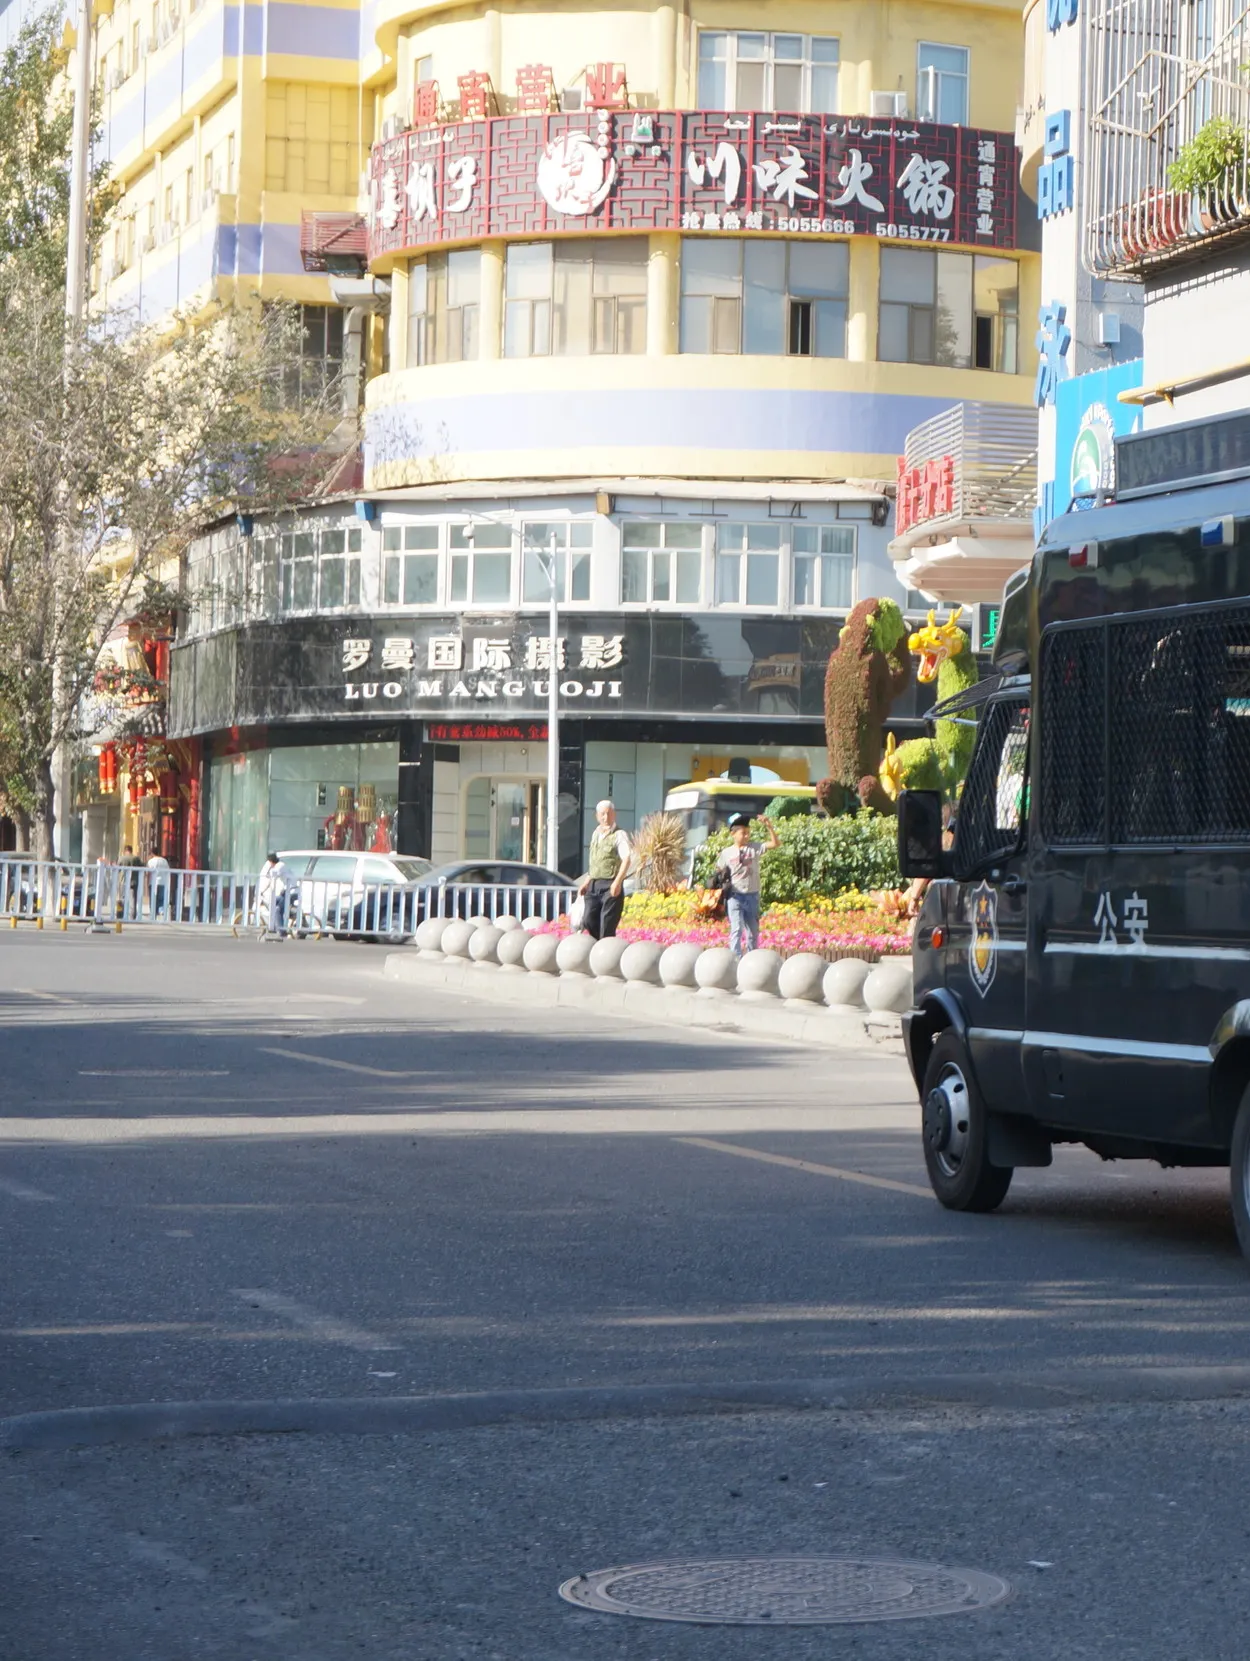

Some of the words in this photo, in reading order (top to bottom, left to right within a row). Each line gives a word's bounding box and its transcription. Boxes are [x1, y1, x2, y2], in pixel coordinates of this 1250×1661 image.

[687, 142, 956, 220] 川味火锅
[975, 140, 997, 236] 通宵营业
[876, 222, 951, 242] 5055777
[342, 635, 625, 672] 罗曼国际摄影
[345, 682, 403, 699] LUO
[418, 679, 623, 698] MANGUOJI
[1094, 891, 1149, 953] 公安
